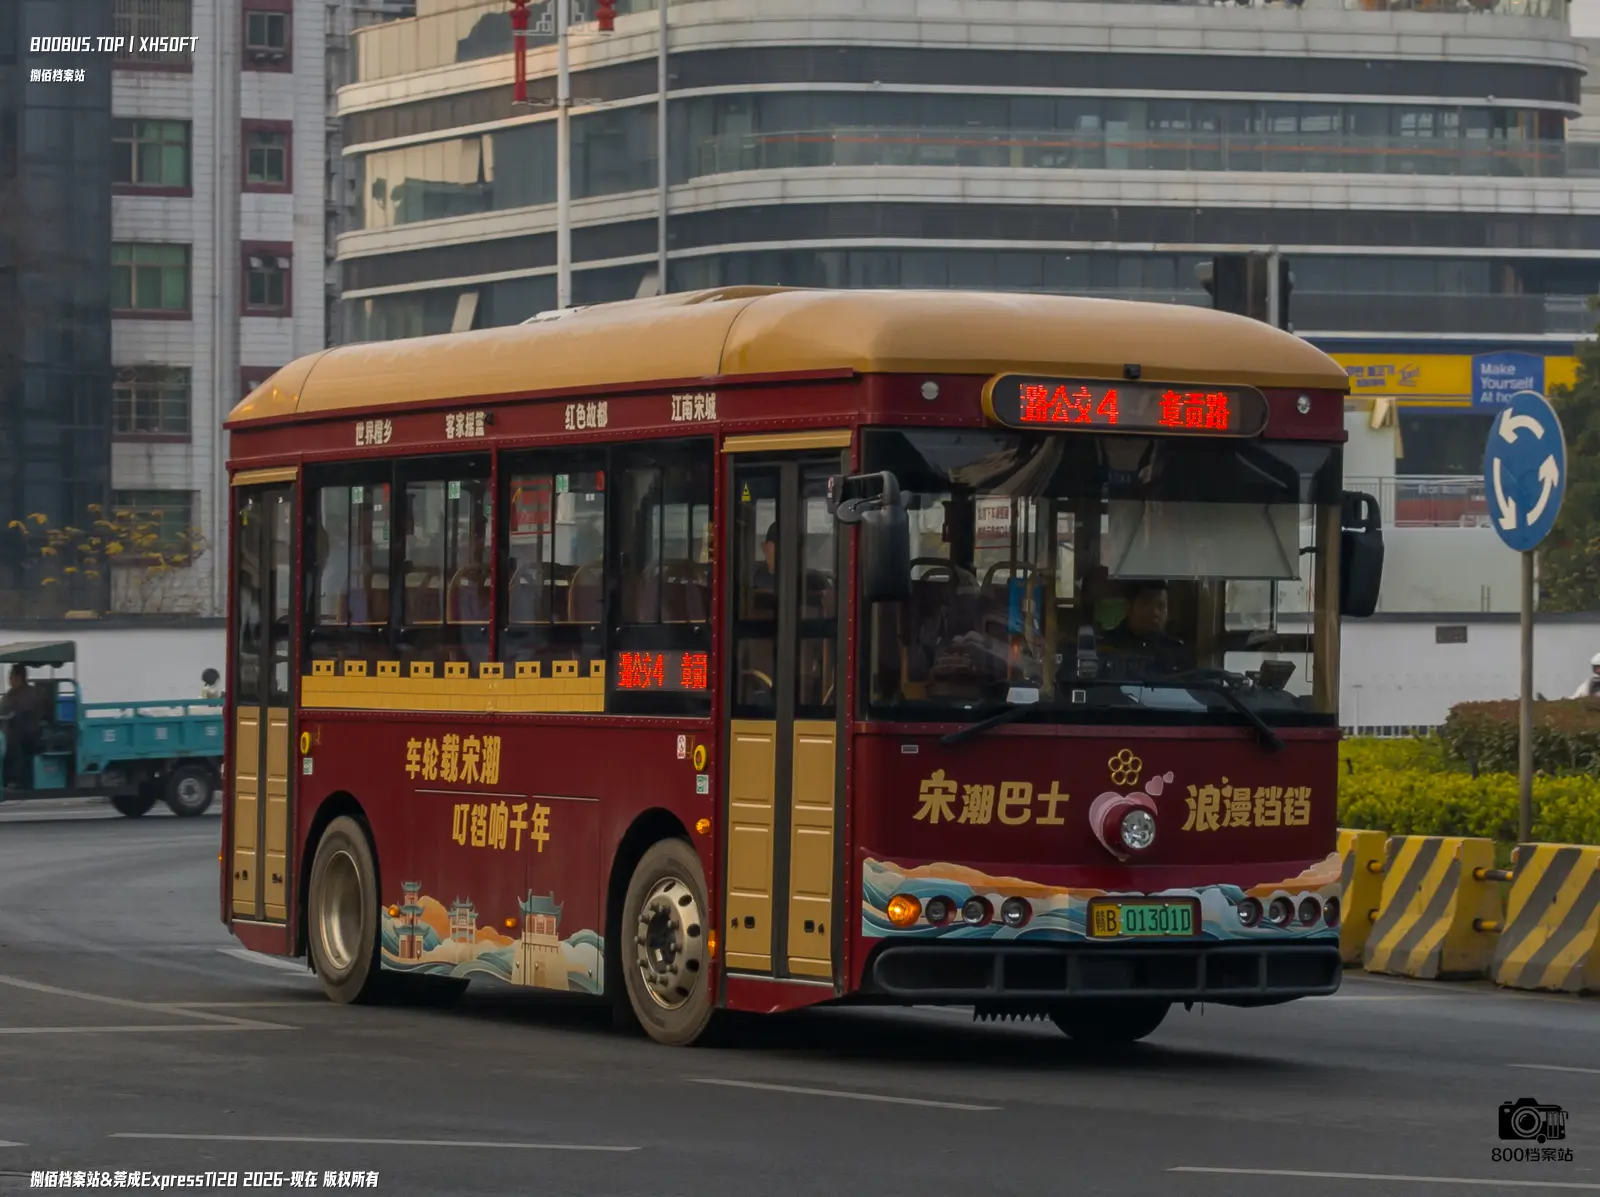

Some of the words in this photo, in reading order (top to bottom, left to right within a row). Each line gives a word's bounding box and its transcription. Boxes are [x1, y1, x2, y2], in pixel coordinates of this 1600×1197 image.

[1480, 363, 1516, 375] Make
[1480, 376, 1534, 390] Yourself
[565, 401, 608, 430] 红色故都
[671, 393, 717, 421] 江南宋城
[405, 733, 501, 785] 车轮载宋潮
[913, 769, 1071, 826] 宋潮巴士
[1181, 777, 1312, 832] 浪漫铛铛
[452, 800, 551, 853] 叮铛响千年
